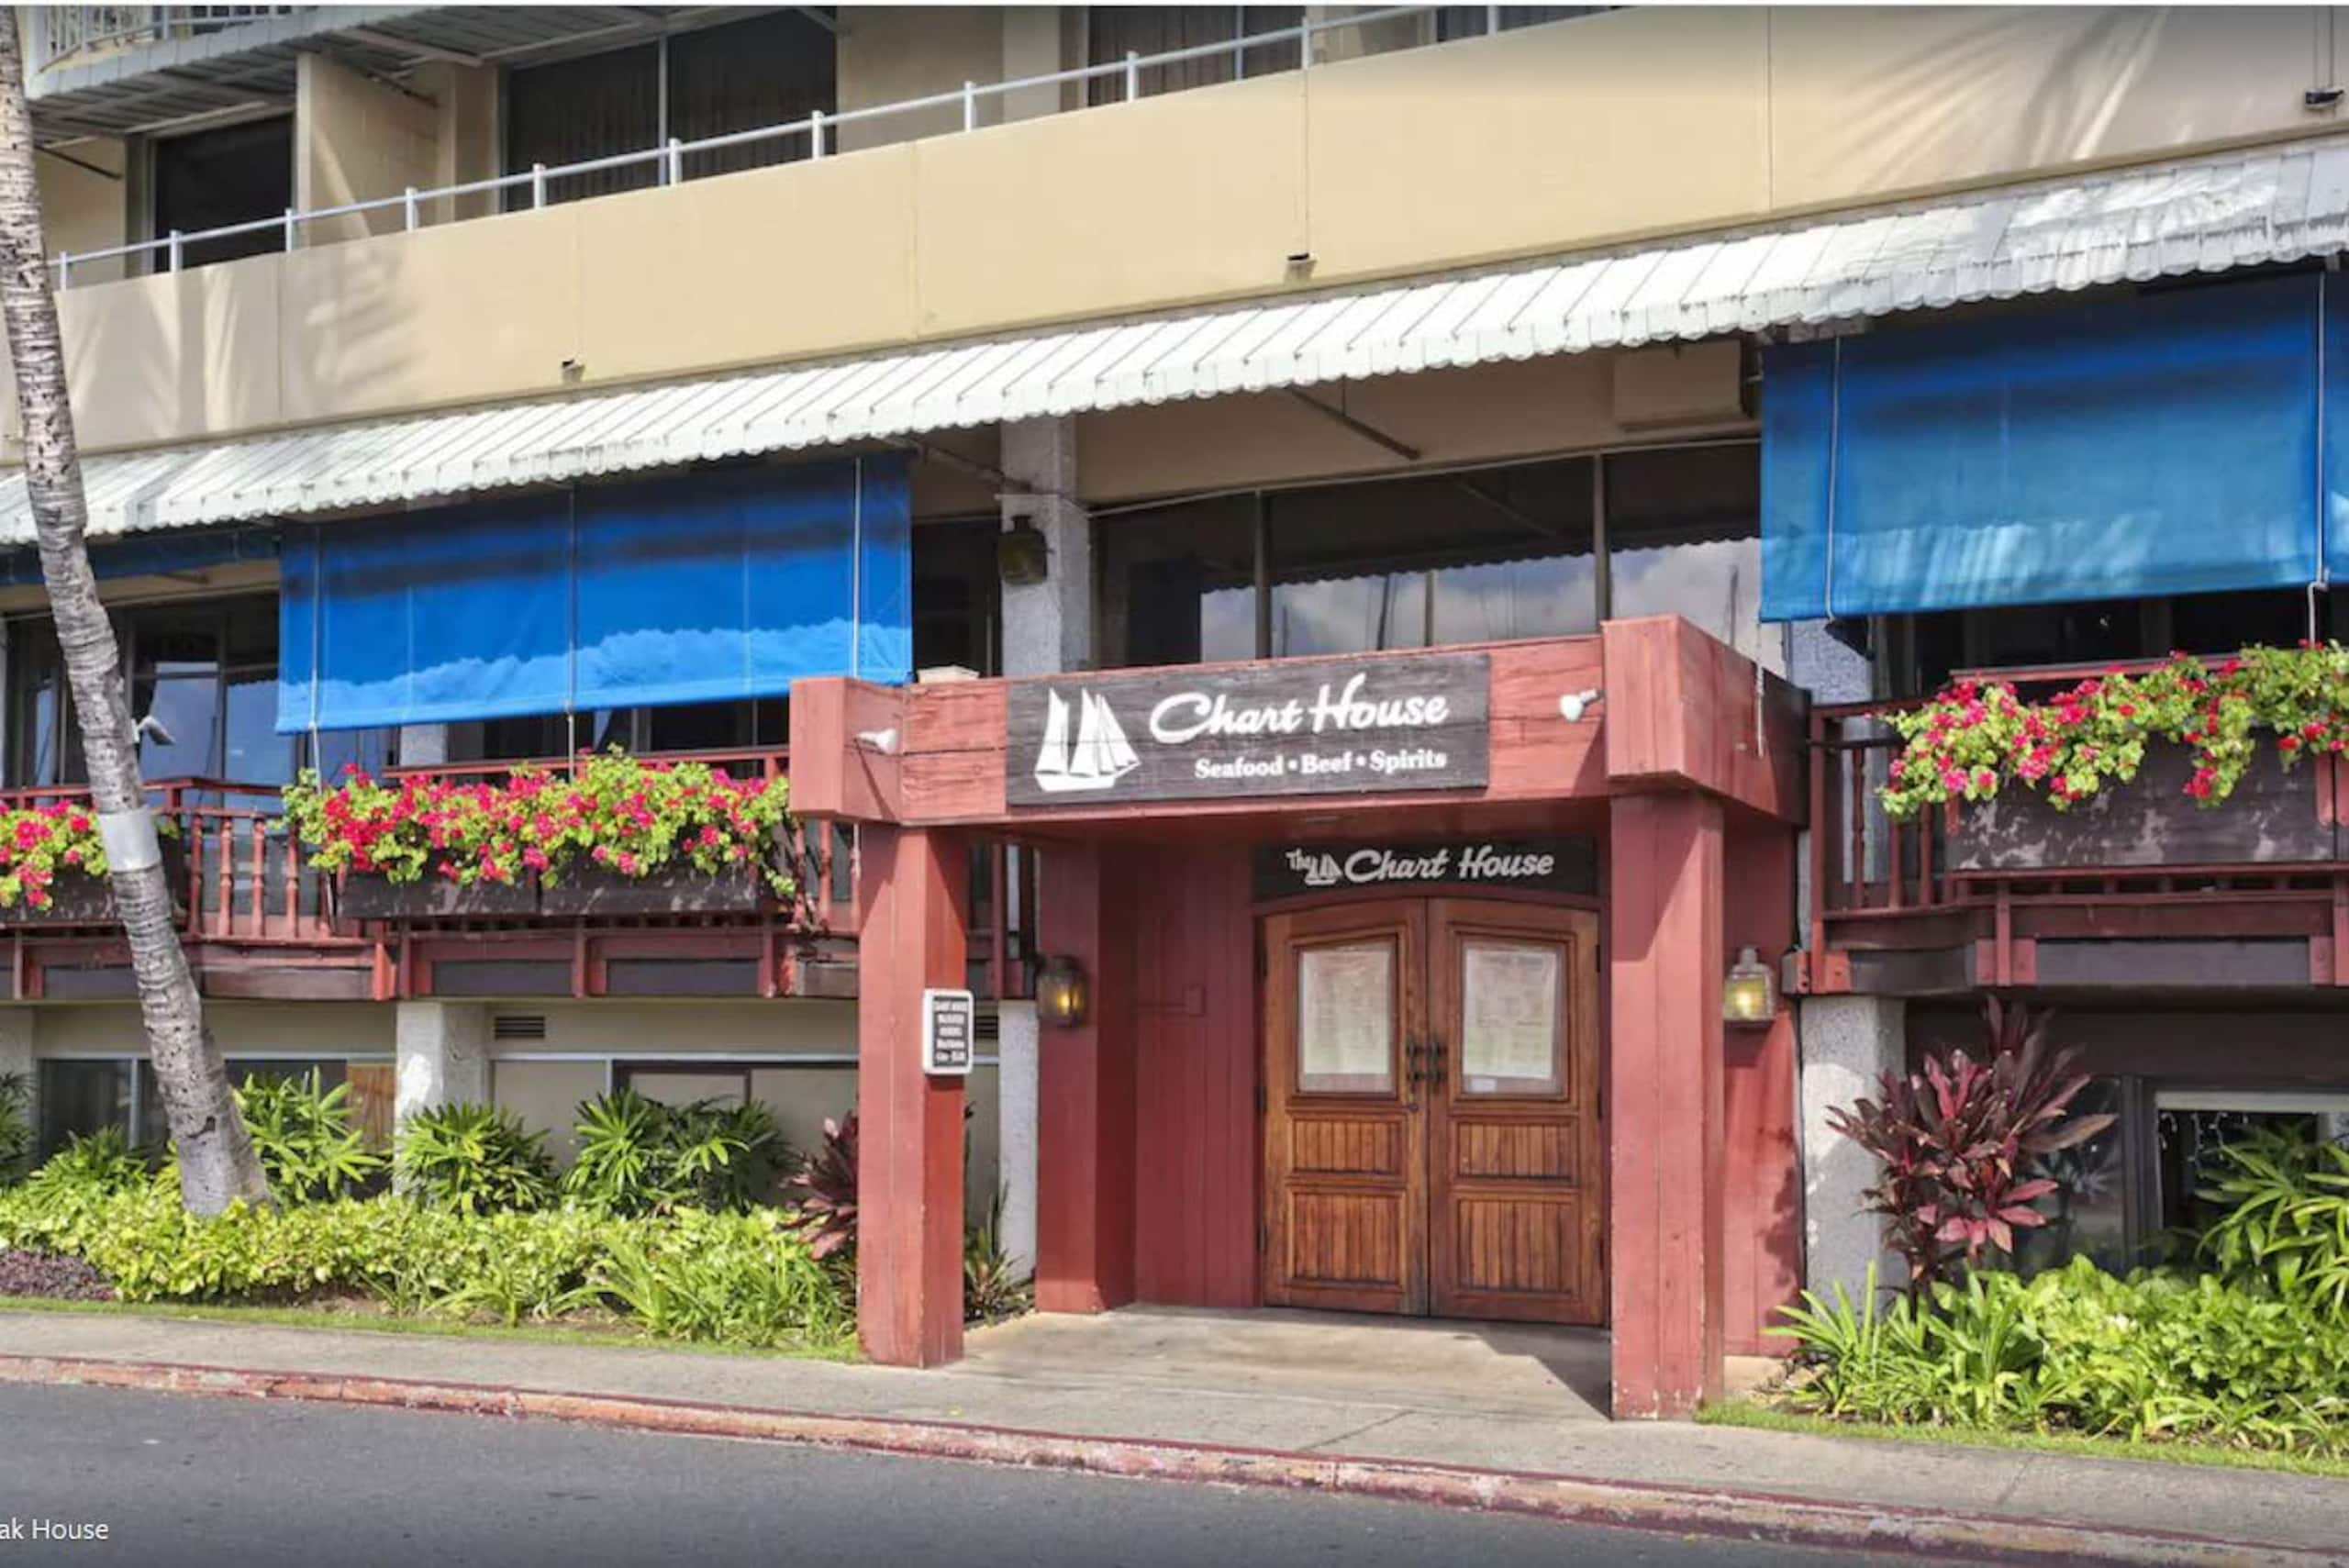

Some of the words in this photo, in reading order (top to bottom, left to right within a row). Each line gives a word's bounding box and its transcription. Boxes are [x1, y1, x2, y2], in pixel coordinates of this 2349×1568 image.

[1150, 692, 1301, 744] Chart
[1309, 673, 1449, 733] House
[1196, 752, 1284, 779] Seafood
[1301, 751, 1353, 775] Beef
[1370, 749, 1447, 773] Spirits
[1344, 849, 1450, 883] Chart
[1458, 846, 1554, 878] House
